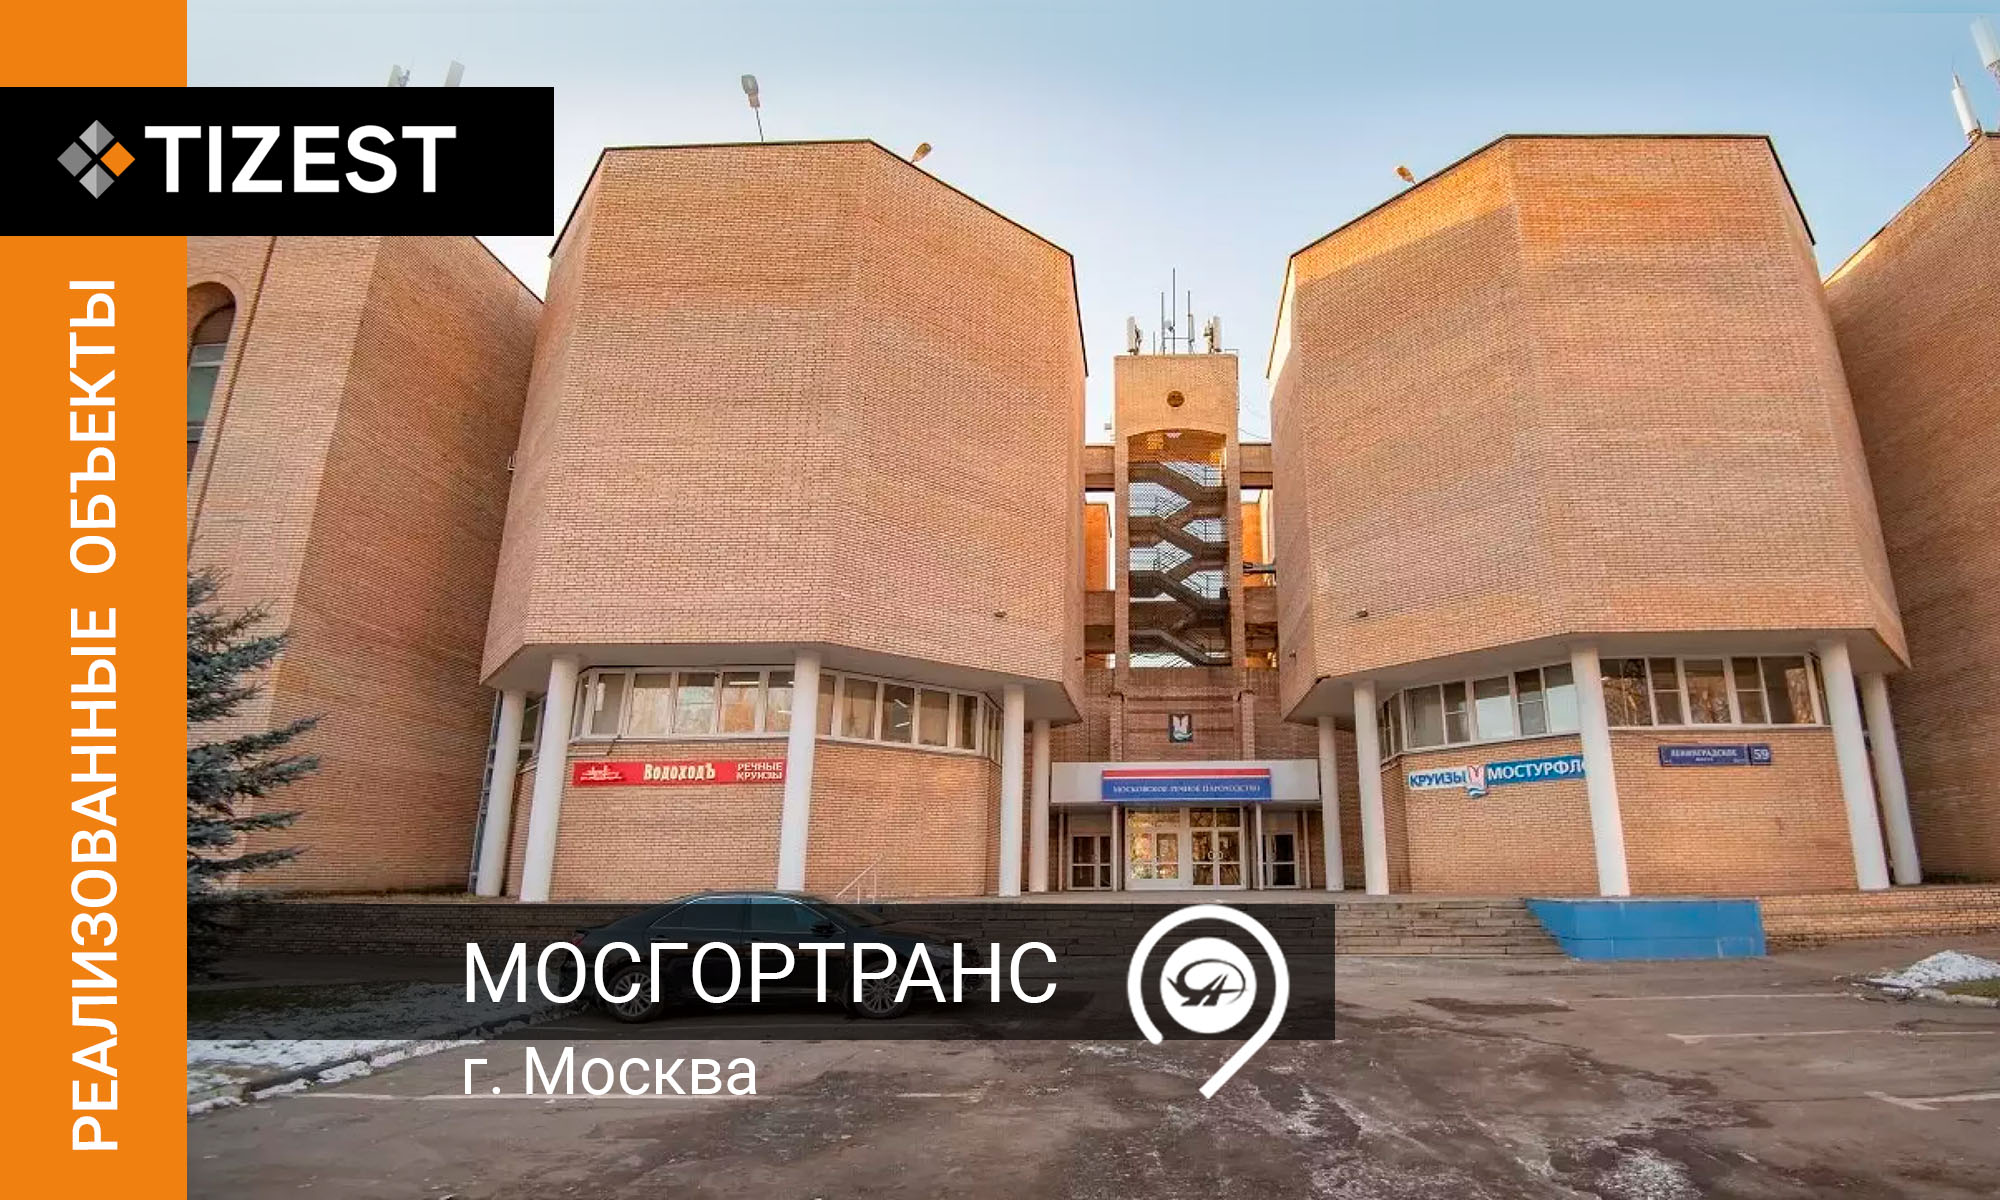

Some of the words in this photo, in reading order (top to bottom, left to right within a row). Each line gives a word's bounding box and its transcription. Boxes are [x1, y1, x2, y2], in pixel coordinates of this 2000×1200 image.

[1753, 748, 1770, 760] 59
[737, 762, 783, 771] РЕЧНЫЕ
[736, 771, 782, 781] КРУИЗЫ
[1409, 771, 1467, 787] КРУИЗЫ
[1487, 758, 1585, 781] МОСТУРФЛ
